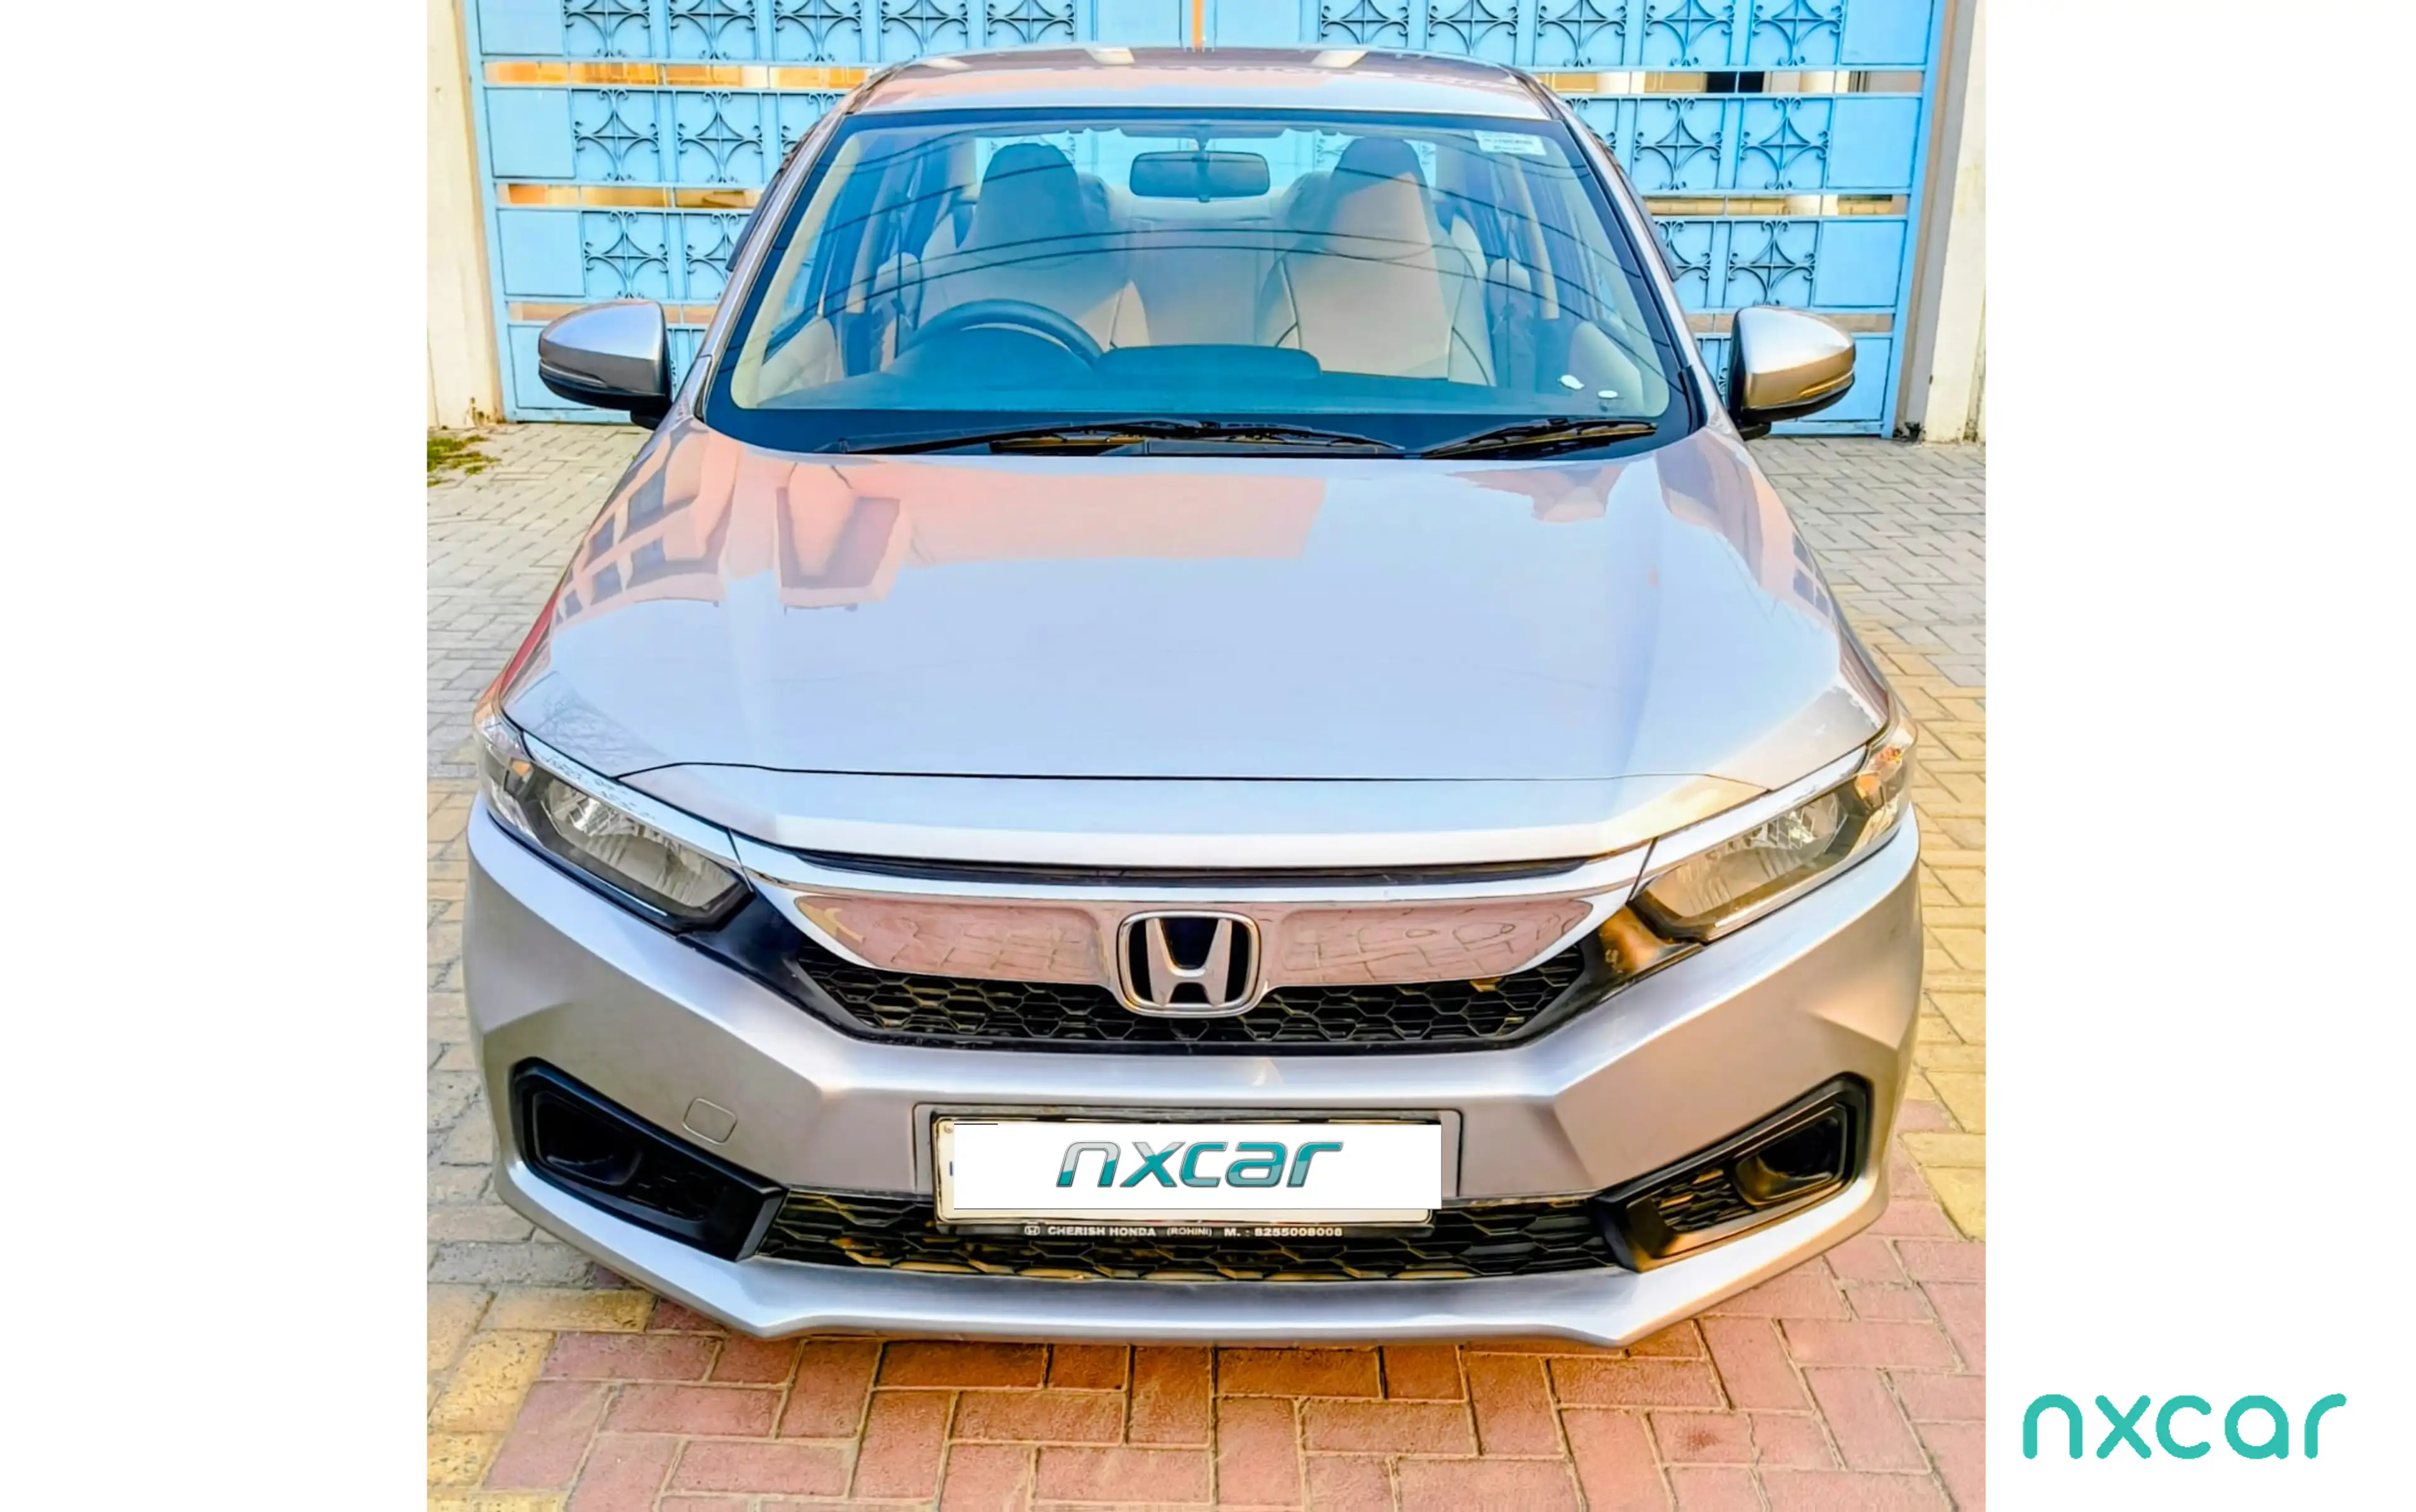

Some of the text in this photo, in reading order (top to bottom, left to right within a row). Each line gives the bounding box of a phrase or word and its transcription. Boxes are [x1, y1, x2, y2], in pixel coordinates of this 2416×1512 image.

[1048, 1226, 1105, 1236] CHERISH
[1109, 1226, 1156, 1236] HONDA
[1166, 1227, 1213, 1236] (ROHINI)
